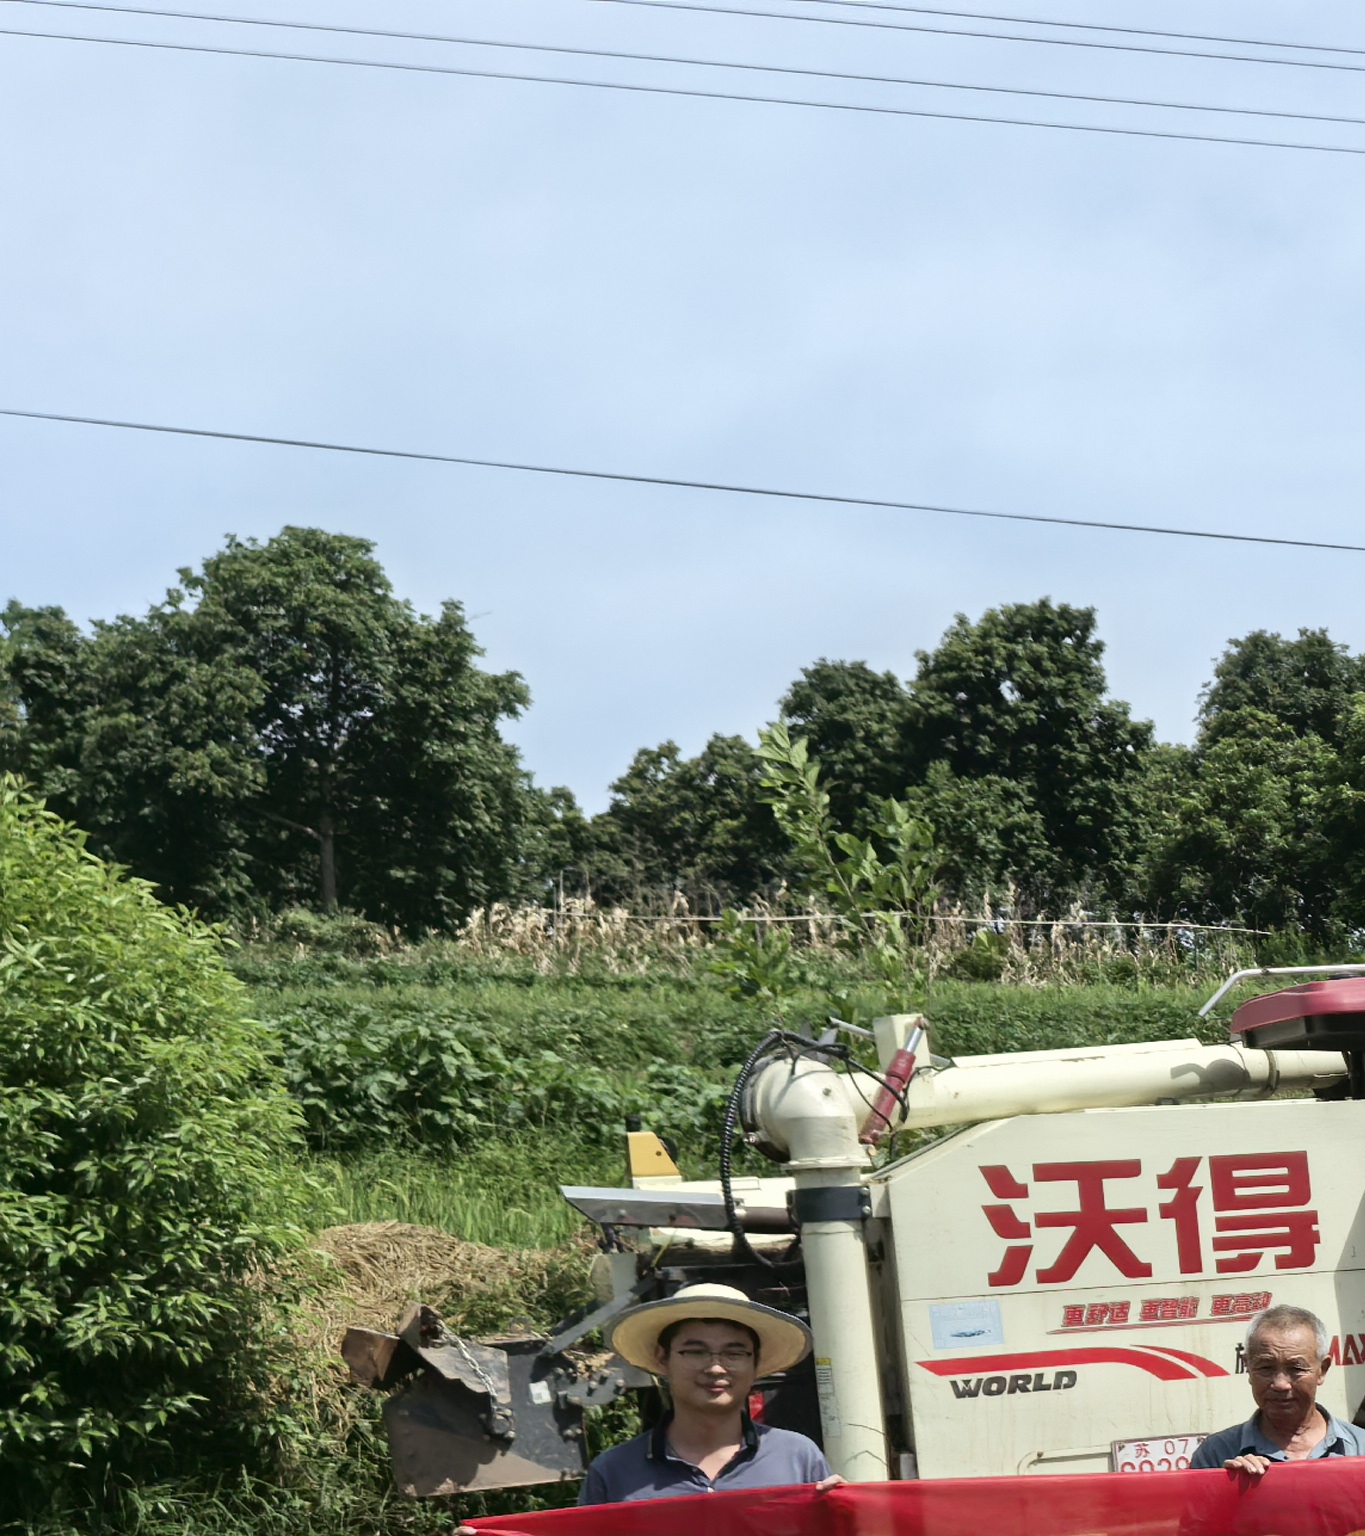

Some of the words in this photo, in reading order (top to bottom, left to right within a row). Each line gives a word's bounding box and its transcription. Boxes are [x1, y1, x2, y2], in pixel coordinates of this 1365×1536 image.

[978, 1150, 1321, 1287] 沃得
[1061, 1300, 1131, 1327] 更舒适
[1139, 1296, 1200, 1321] 更智能
[949, 1370, 1078, 1399] WORLD
[1133, 1442, 1150, 1458] 苏
[1164, 1438, 1190, 1455] 07
